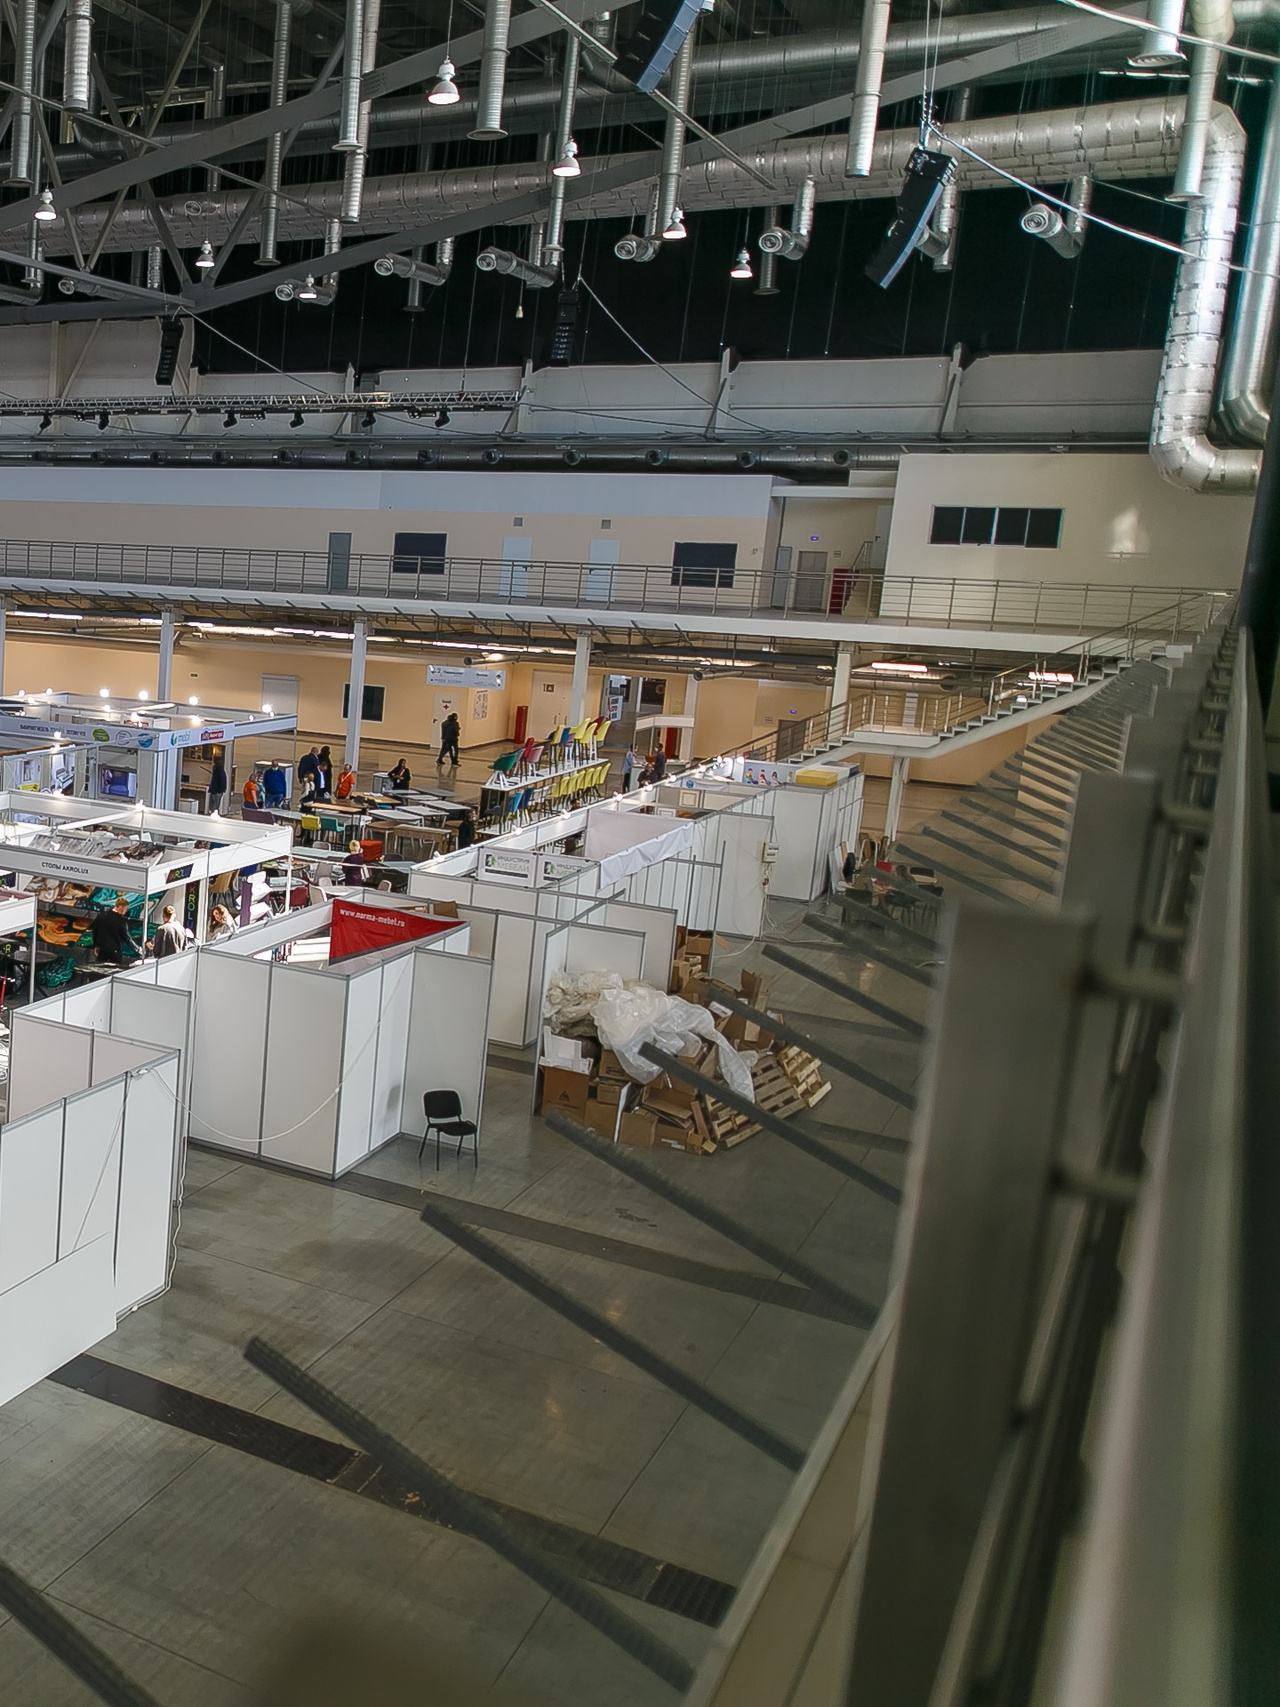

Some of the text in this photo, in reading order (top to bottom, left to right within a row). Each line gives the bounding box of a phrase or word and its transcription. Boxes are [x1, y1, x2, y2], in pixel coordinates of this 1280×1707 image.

[42, 862, 61, 870] СТОЛЫ
[62, 865, 89, 875] AKROLUX
[340, 908, 405, 927] www.norma-mebel.ru
